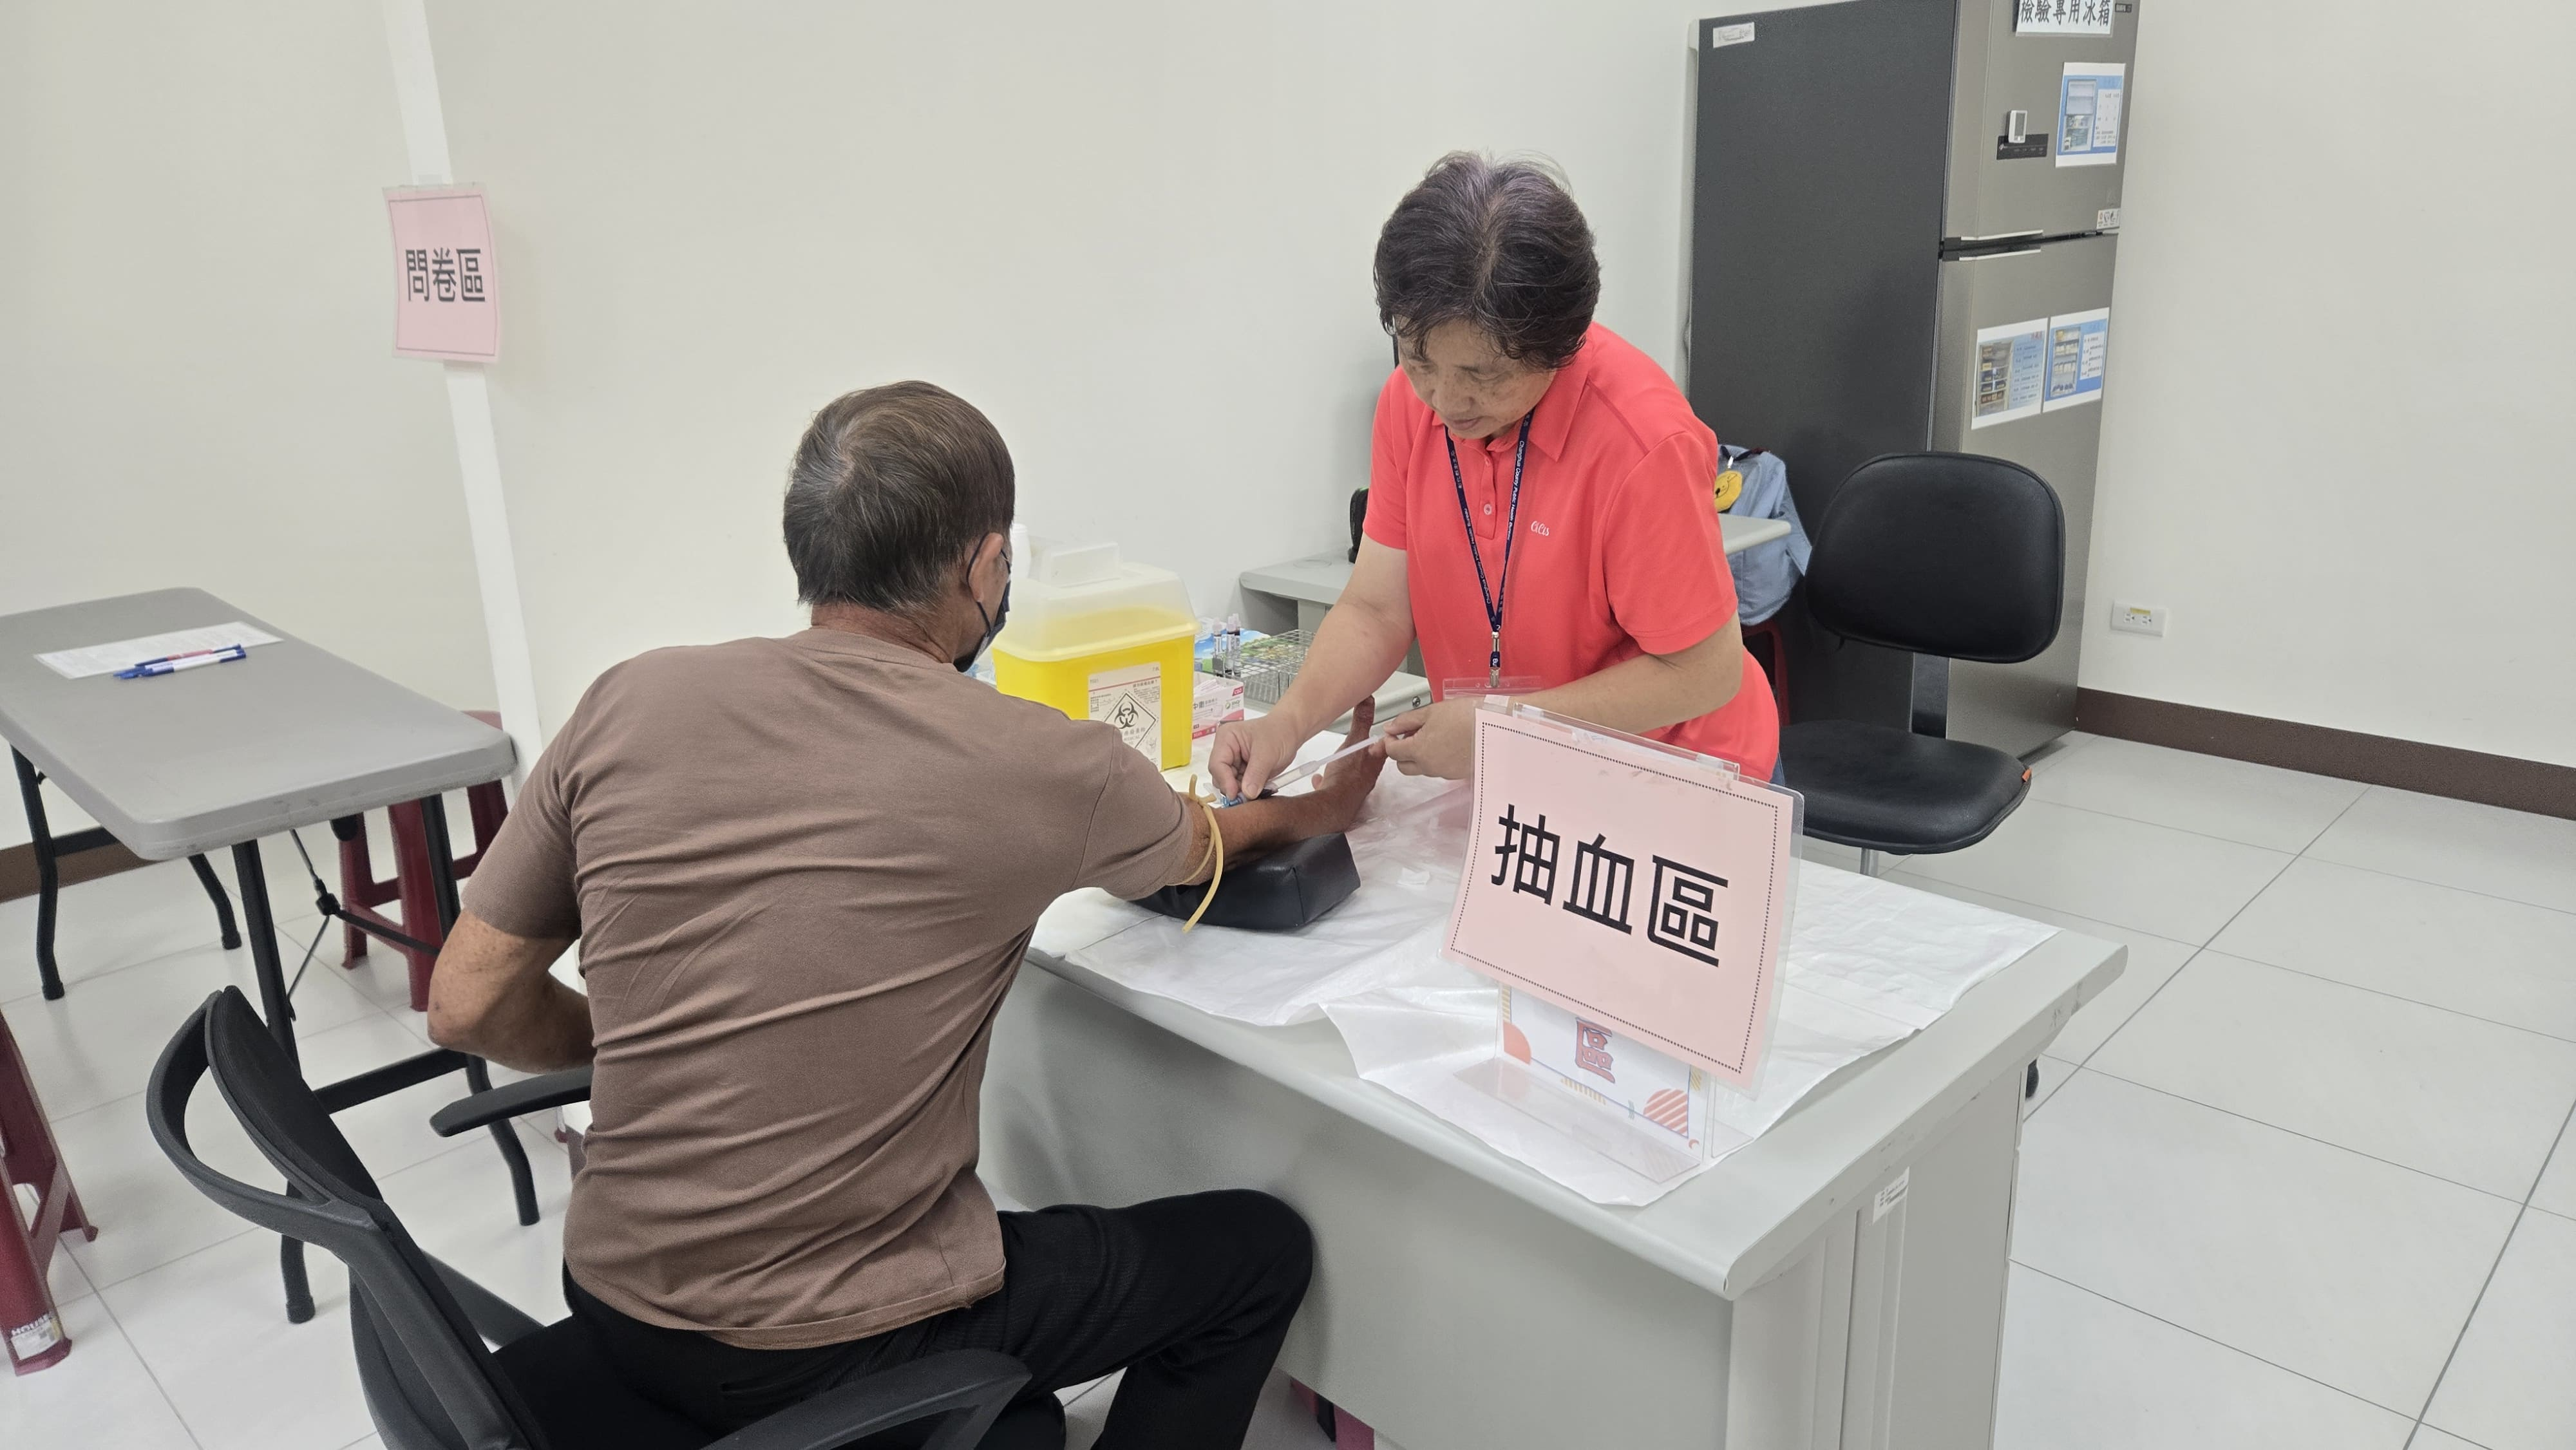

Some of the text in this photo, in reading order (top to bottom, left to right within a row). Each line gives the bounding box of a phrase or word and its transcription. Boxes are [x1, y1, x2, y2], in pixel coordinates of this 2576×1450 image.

[2020, 0, 2110, 26] 檢驗專用冰箱
[405, 247, 486, 302] 問卷區
[1515, 440, 1524, 467] Changhua
[1490, 804, 1729, 968] 抽血區
[1575, 1016, 1616, 1084] 區
